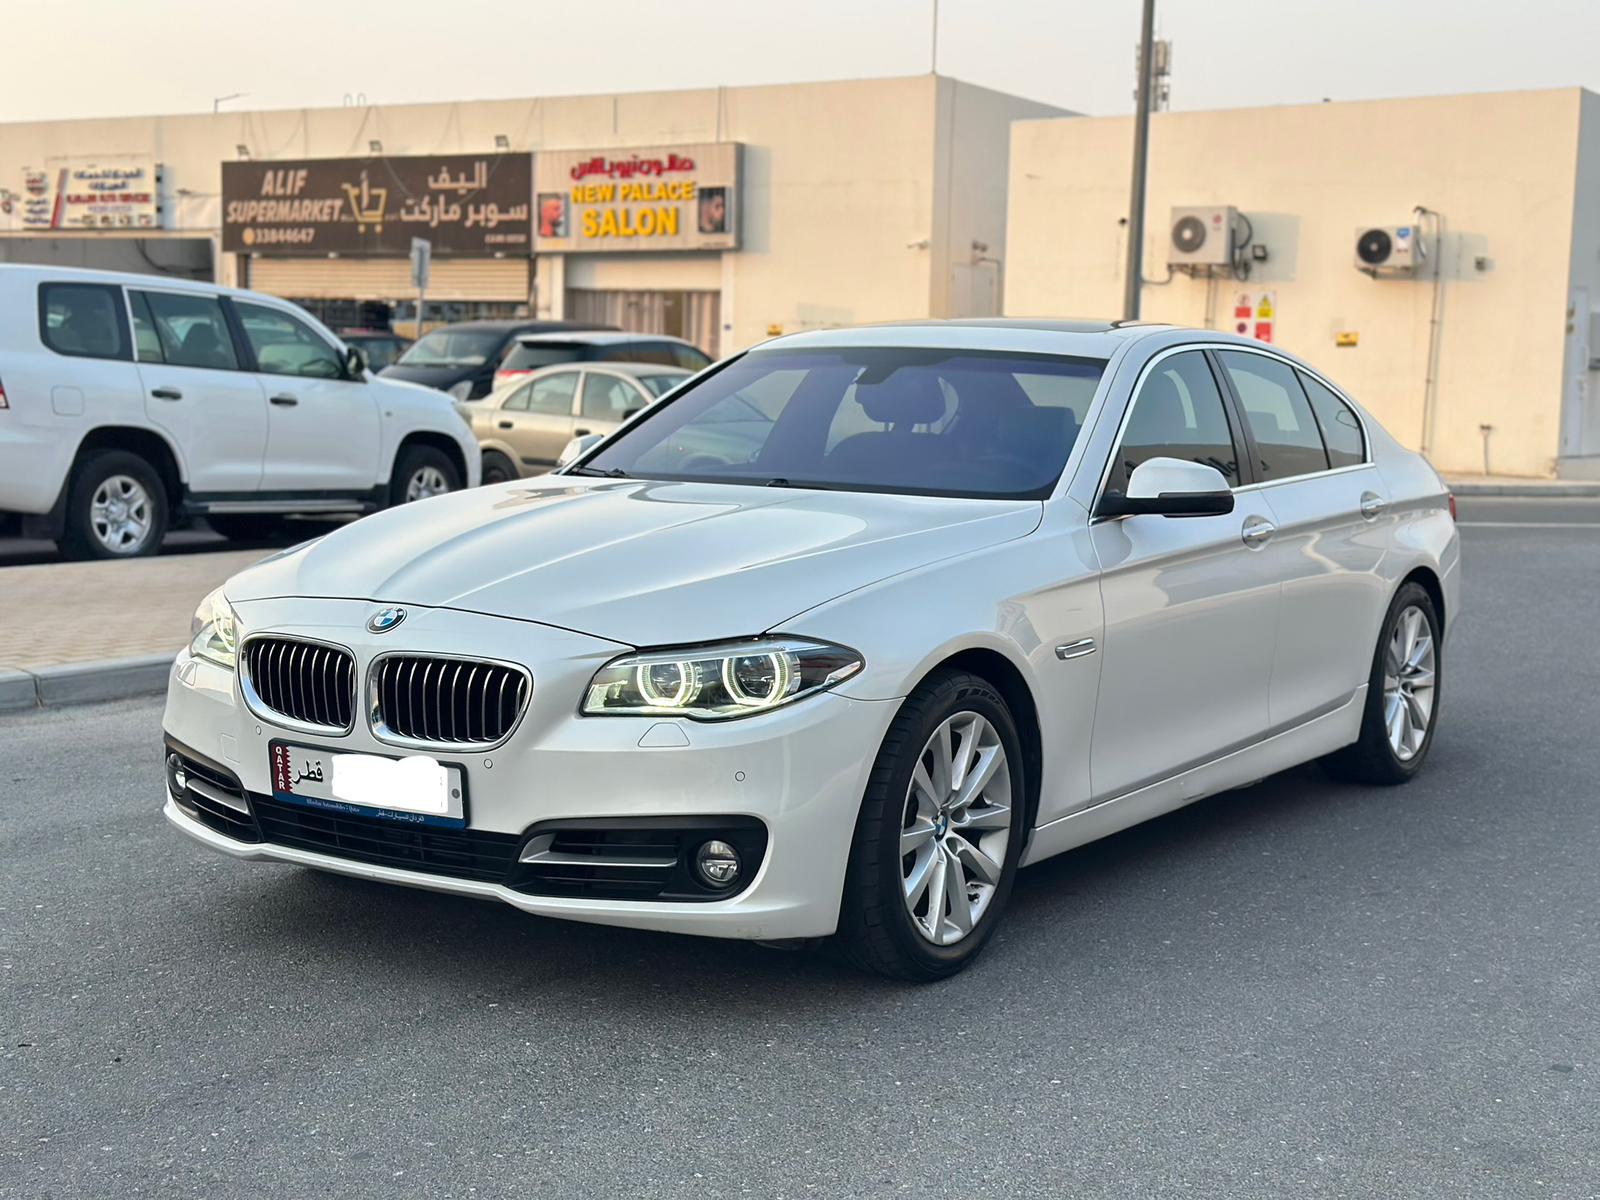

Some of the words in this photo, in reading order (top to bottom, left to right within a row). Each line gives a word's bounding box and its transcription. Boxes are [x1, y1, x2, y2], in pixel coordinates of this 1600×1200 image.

[261, 169, 308, 195] ALIF
[428, 161, 488, 194] اليف
[572, 185, 616, 203] NEW
[621, 182, 696, 201] PALACE
[227, 199, 343, 223] SUPERMARKET
[400, 194, 461, 228] ماركت
[464, 202, 529, 227] سوبر
[583, 207, 679, 238] SALON
[275, 746, 286, 790] QATAR
[293, 761, 323, 784] قطر
